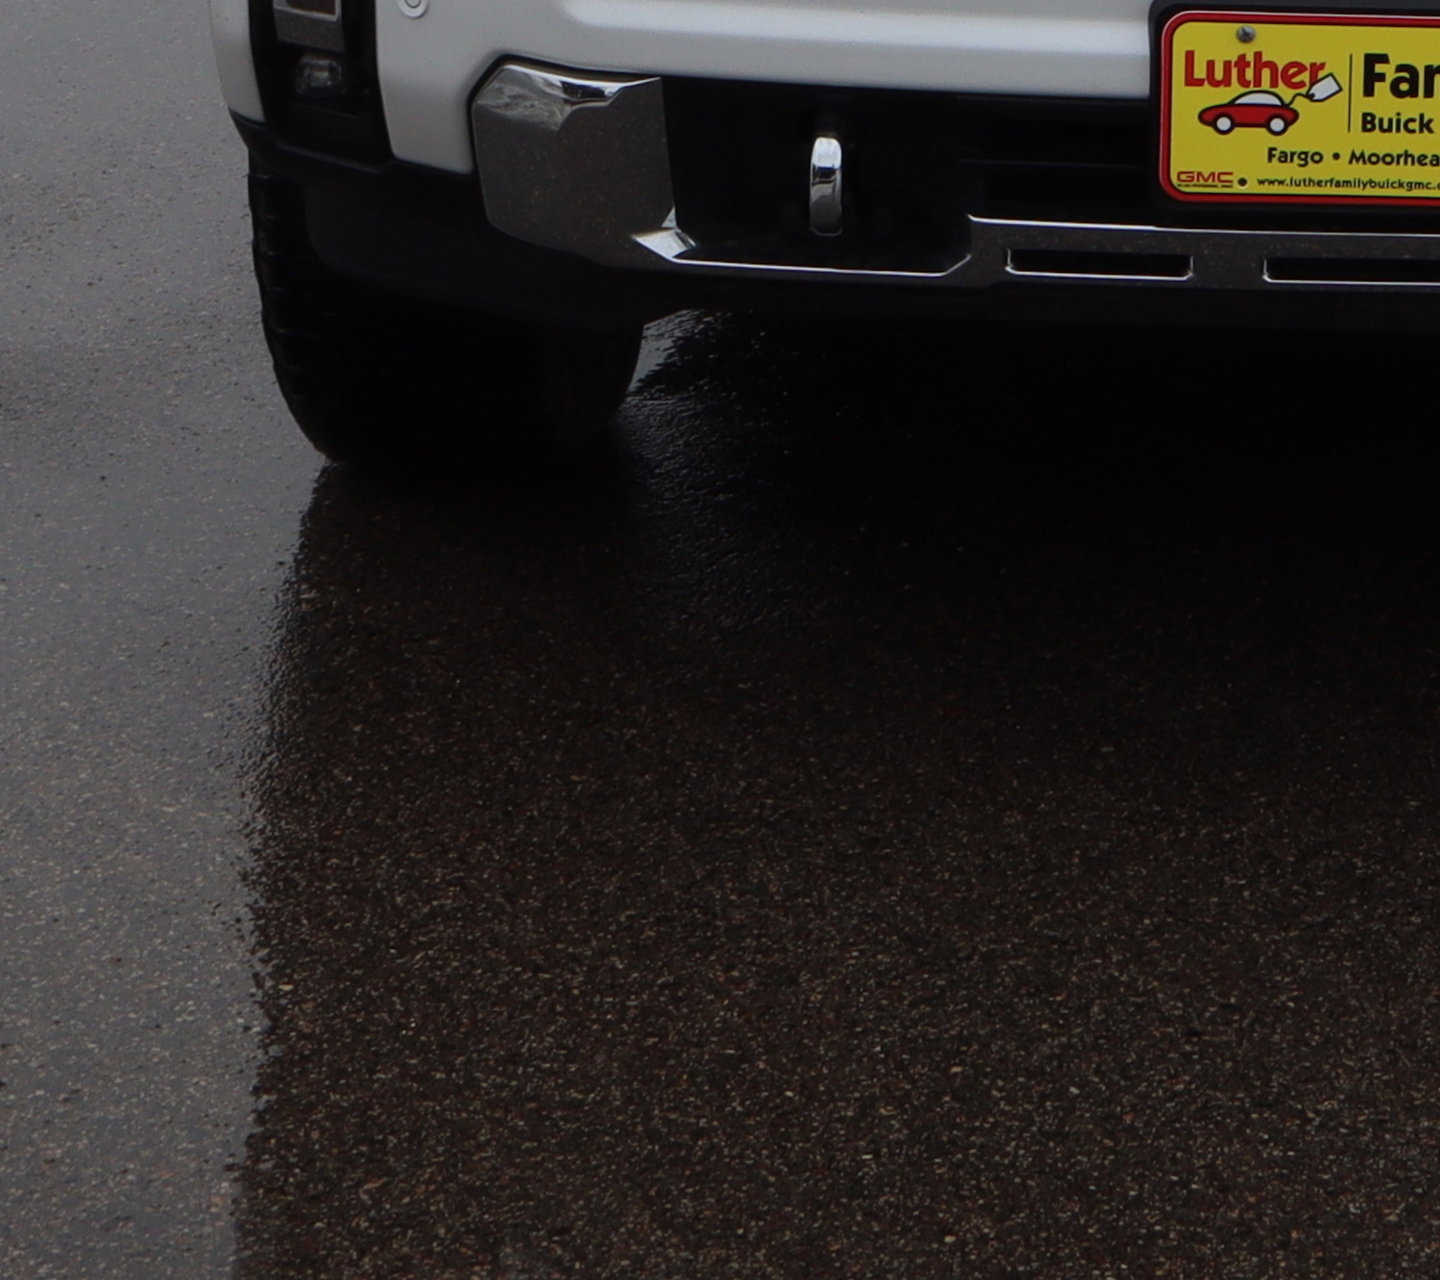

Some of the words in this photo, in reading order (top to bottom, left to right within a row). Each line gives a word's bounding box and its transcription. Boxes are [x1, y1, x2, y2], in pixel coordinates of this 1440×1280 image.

[1184, 50, 1326, 89] Luther
[1361, 113, 1434, 134] Buick
[1267, 147, 1324, 167] Fargo
[1177, 171, 1233, 184] GMC
